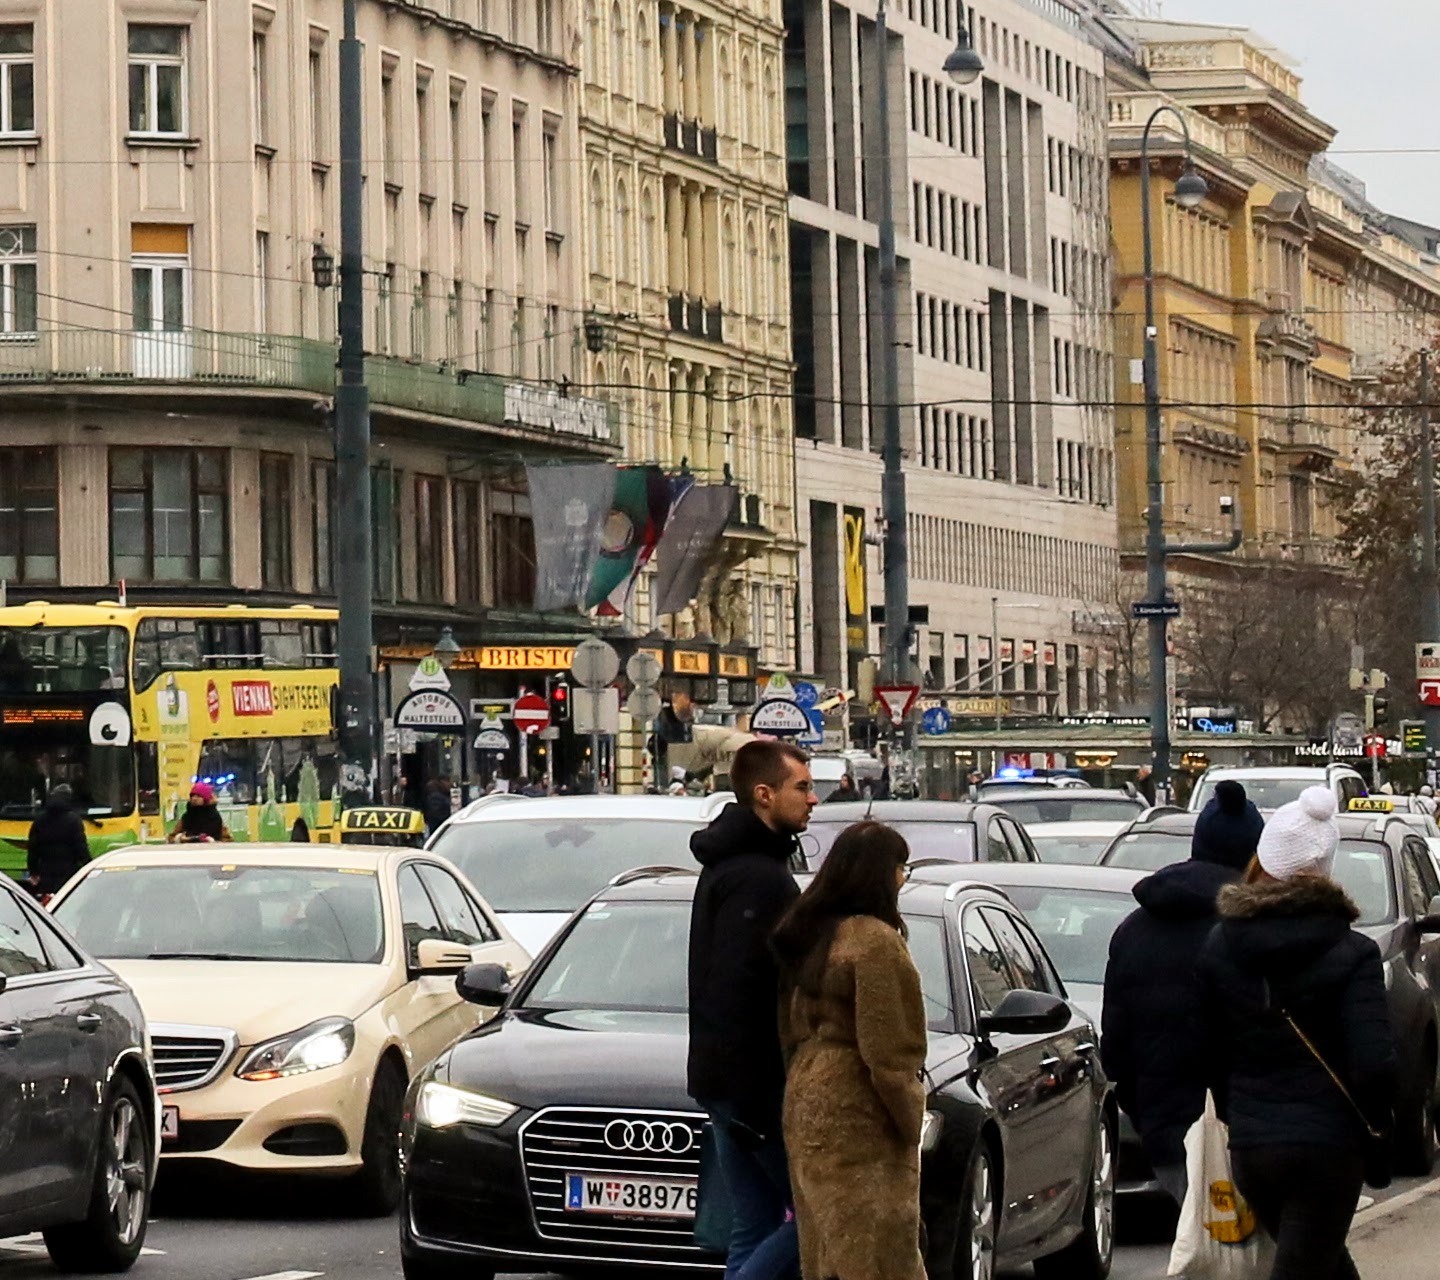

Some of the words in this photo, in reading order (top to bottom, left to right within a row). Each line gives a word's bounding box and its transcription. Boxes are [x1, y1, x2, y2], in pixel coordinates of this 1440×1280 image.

[489, 648, 575, 667] BRISTO
[232, 684, 272, 712] VIENNA
[273, 685, 331, 710] SIGHTSEEIN
[412, 693, 451, 709] AUTOBUS
[403, 714, 458, 724] HALTESTELLE
[1356, 800, 1387, 809] TAXI
[353, 811, 406, 828] TAXI
[587, 1181, 604, 1206] W
[623, 1183, 698, 1211] 38976
